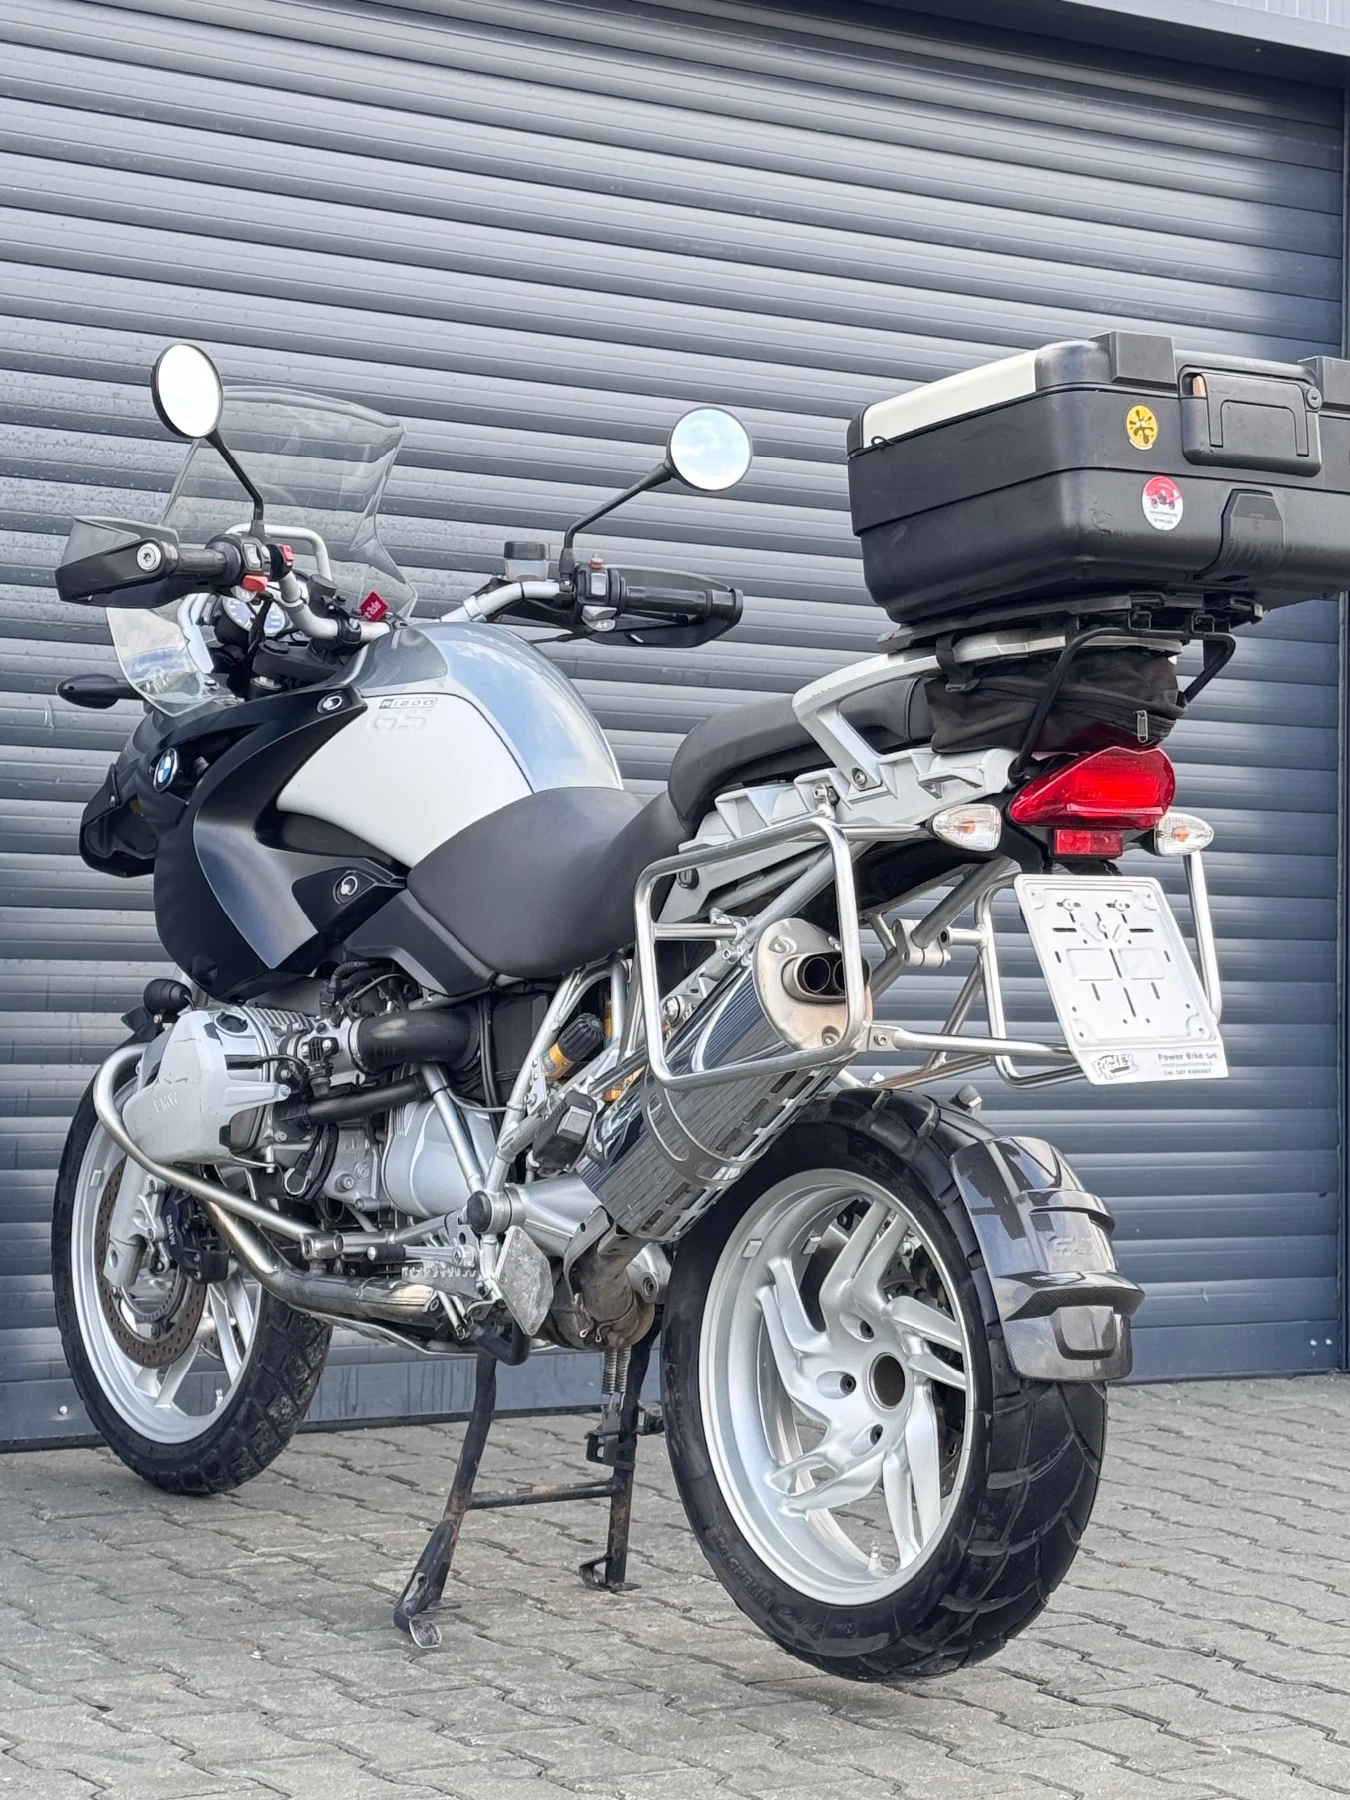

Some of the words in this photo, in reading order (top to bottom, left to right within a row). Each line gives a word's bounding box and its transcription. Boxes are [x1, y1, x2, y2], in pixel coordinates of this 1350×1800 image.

[1157, 1053, 1184, 1061] Power
[166, 1214, 176, 1245] BMW
[711, 1535, 774, 1608] MICHELIN
